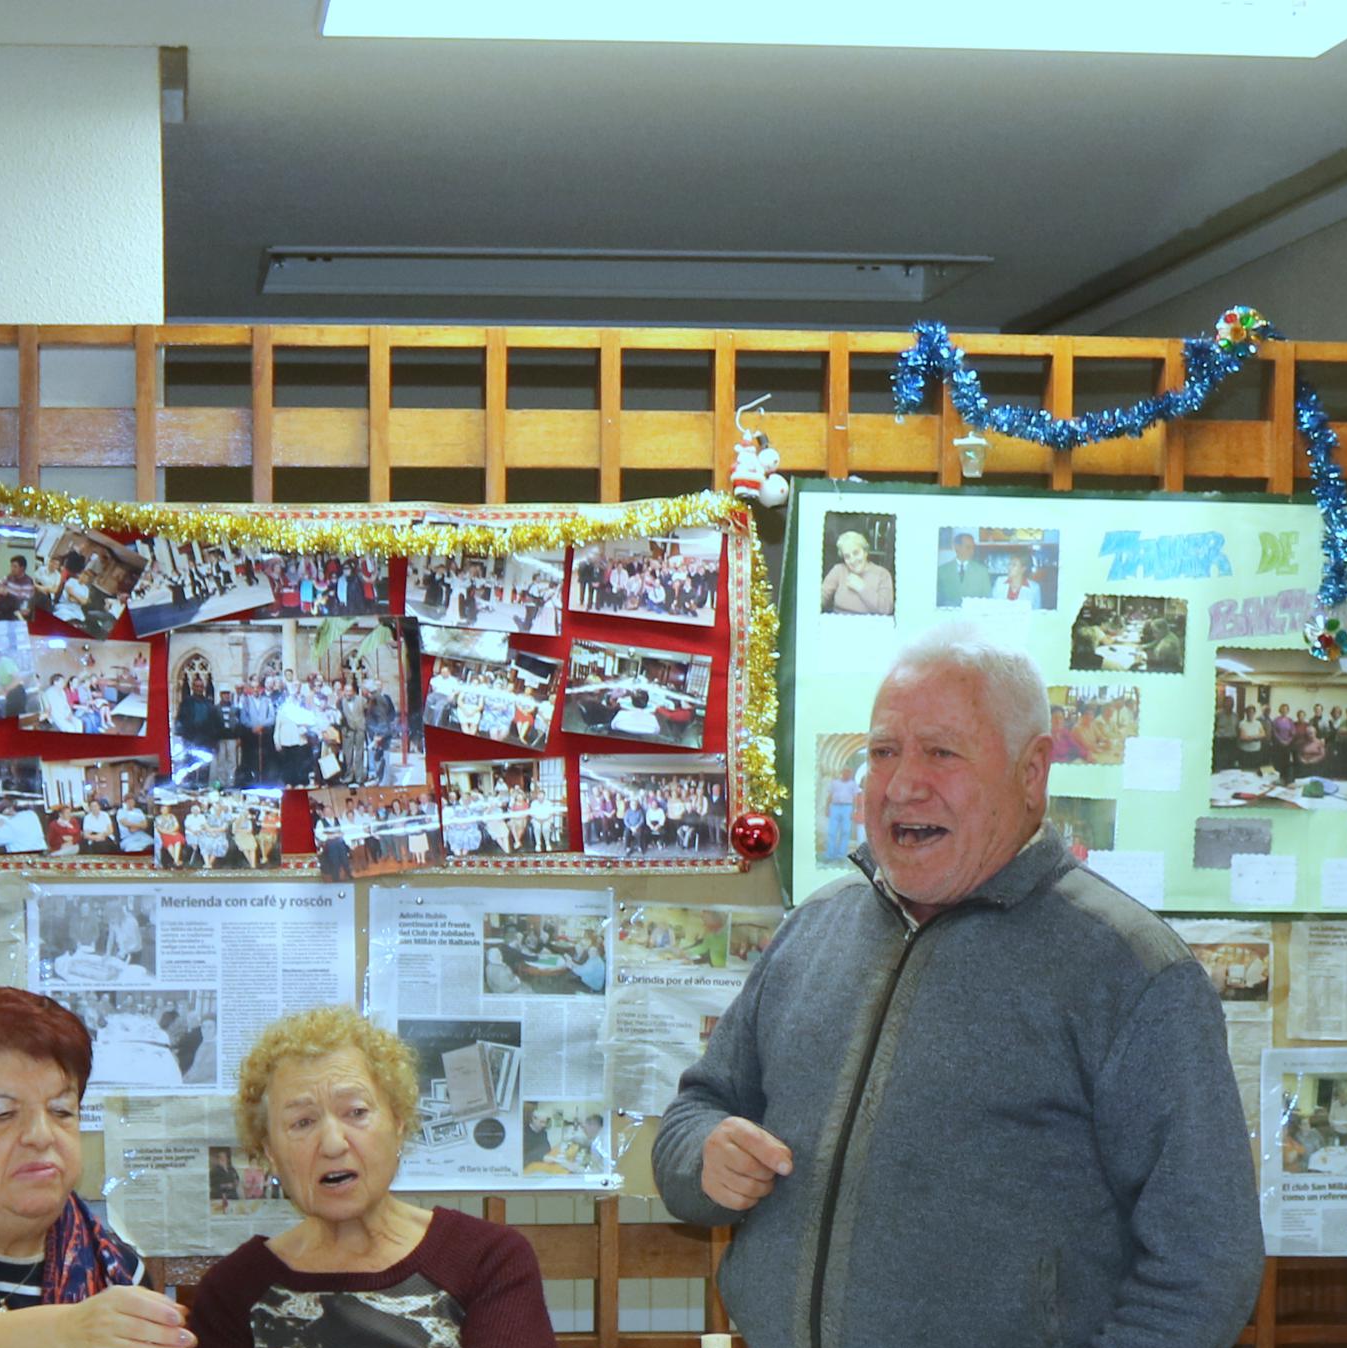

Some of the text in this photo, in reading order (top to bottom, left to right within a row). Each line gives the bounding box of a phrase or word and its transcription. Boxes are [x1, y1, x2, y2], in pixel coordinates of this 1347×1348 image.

[1256, 531, 1300, 576] DE
[161, 893, 333, 910] Merienda con café y roscón
[633, 974, 665, 986] brindis
[666, 977, 682, 987] por
[684, 976, 693, 986] el
[694, 976, 712, 987] año
[713, 978, 743, 988] nuevo
[1282, 1183, 1291, 1192] El
[1292, 1182, 1310, 1192] club
[1311, 1183, 1326, 1191] San
[1282, 1194, 1305, 1202] como
